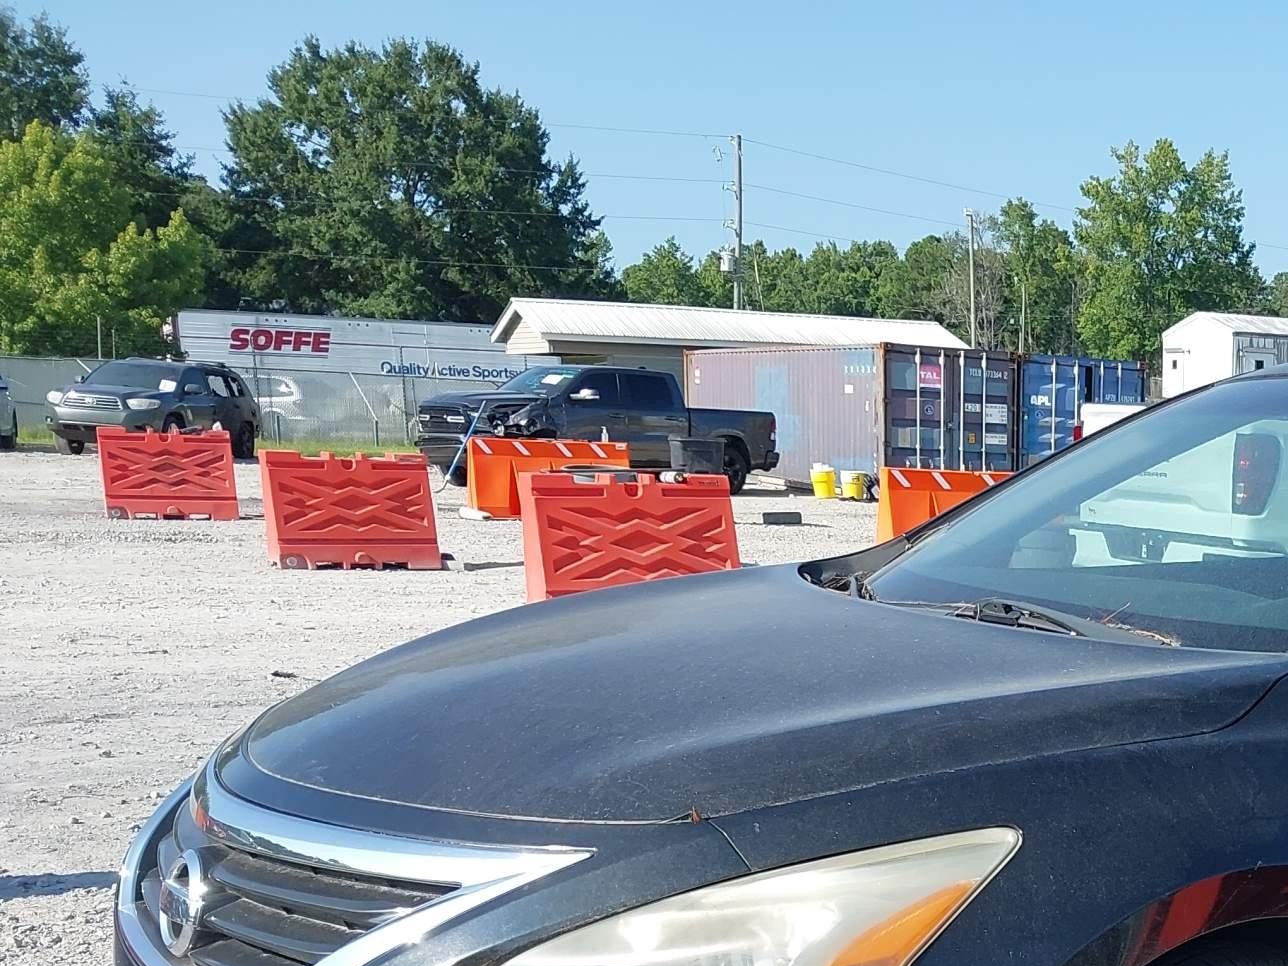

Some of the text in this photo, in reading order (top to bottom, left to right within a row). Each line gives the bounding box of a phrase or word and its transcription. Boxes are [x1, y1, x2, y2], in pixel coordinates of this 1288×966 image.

[229, 328, 331, 353] SOFFE
[381, 361, 429, 378] Quality
[432, 362, 470, 377] Active
[920, 371, 941, 380] TAL
[1030, 394, 1051, 406] APL
